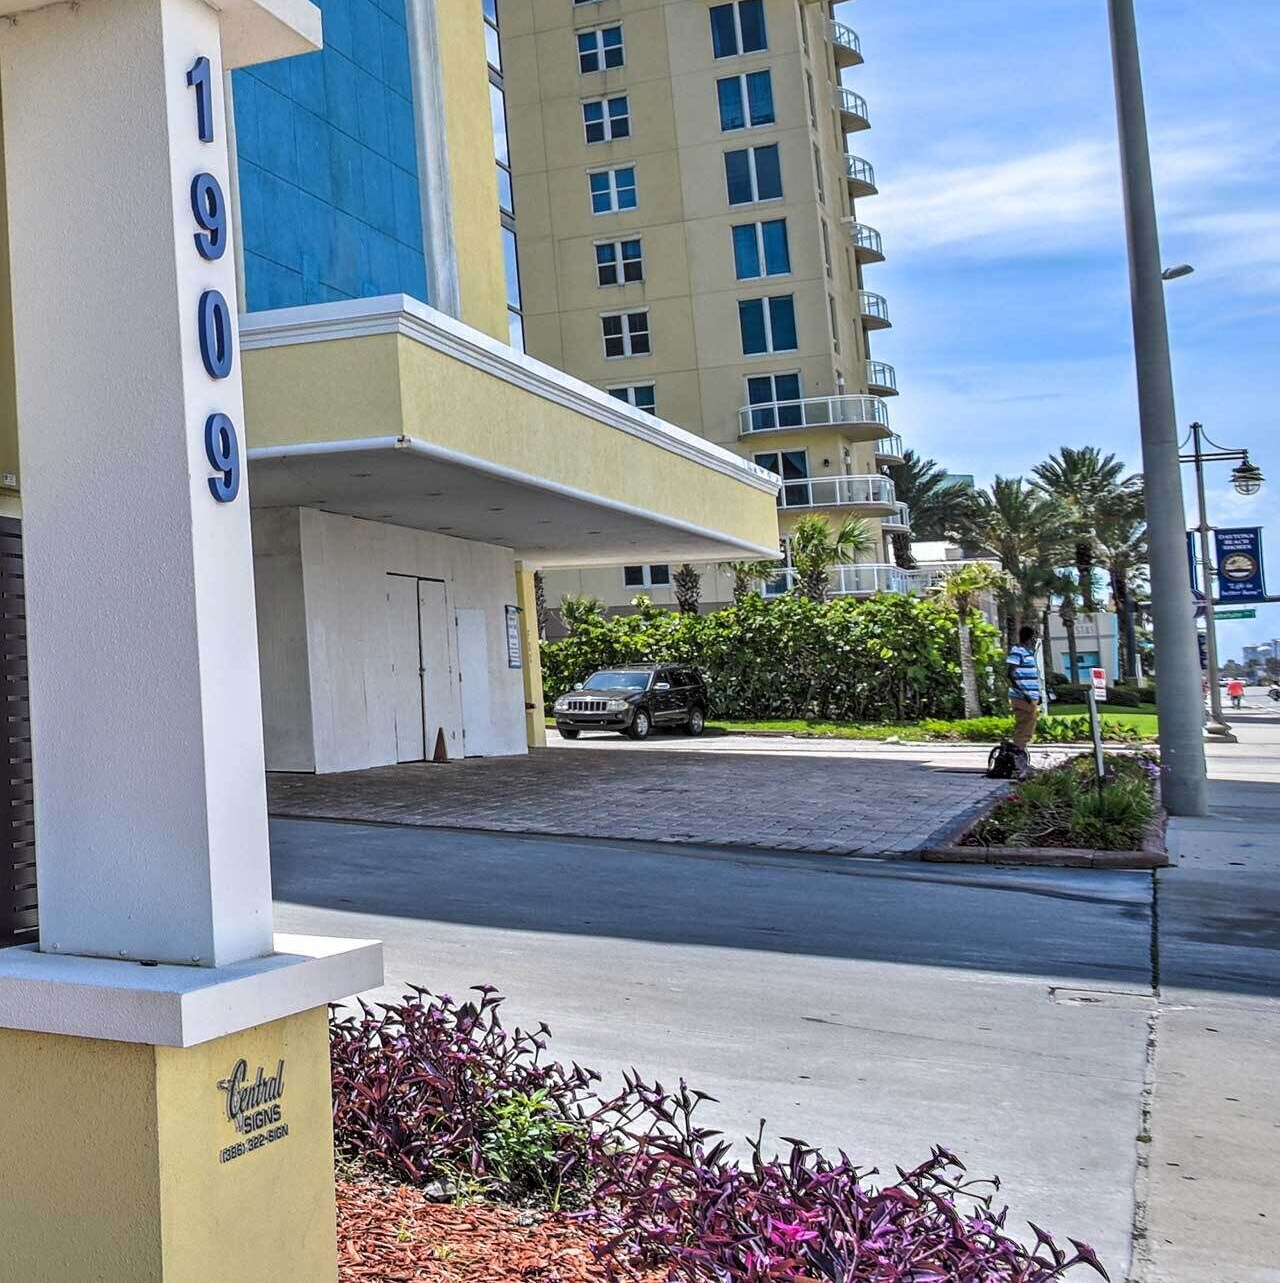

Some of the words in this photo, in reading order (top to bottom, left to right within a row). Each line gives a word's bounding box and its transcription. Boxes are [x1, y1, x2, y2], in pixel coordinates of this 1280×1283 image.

[217, 1058, 284, 1120] Central
[243, 1104, 281, 1134] SIGNS
[247, 1124, 289, 1152] 322-SIGN
